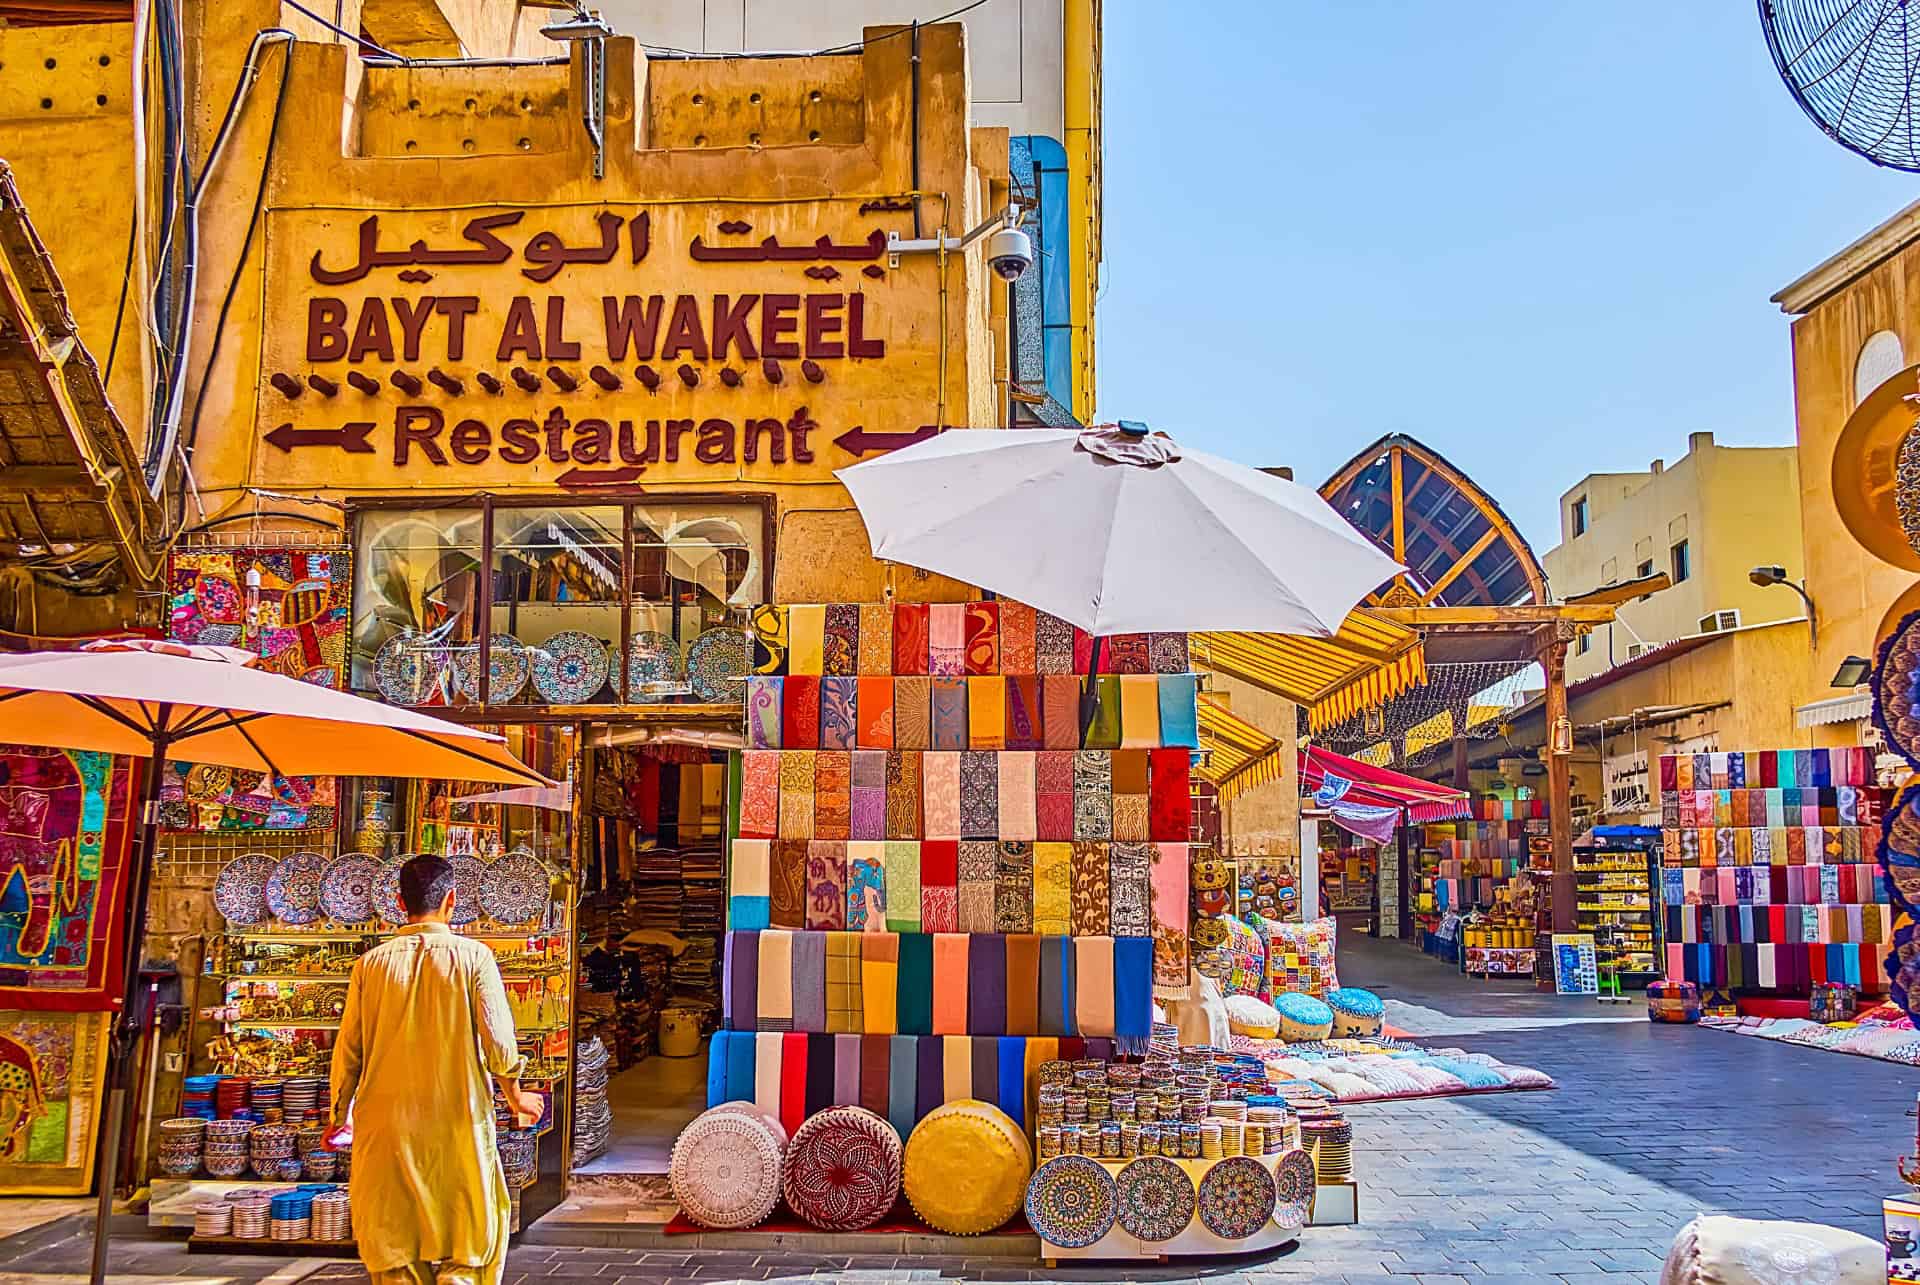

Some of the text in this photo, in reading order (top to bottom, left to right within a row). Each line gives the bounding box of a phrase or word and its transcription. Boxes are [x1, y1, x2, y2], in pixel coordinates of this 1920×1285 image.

[309, 210, 887, 286] بيت الوكيل
[306, 292, 885, 363] BAYT AL WAKEEL
[393, 404, 821, 466] Restaurant
